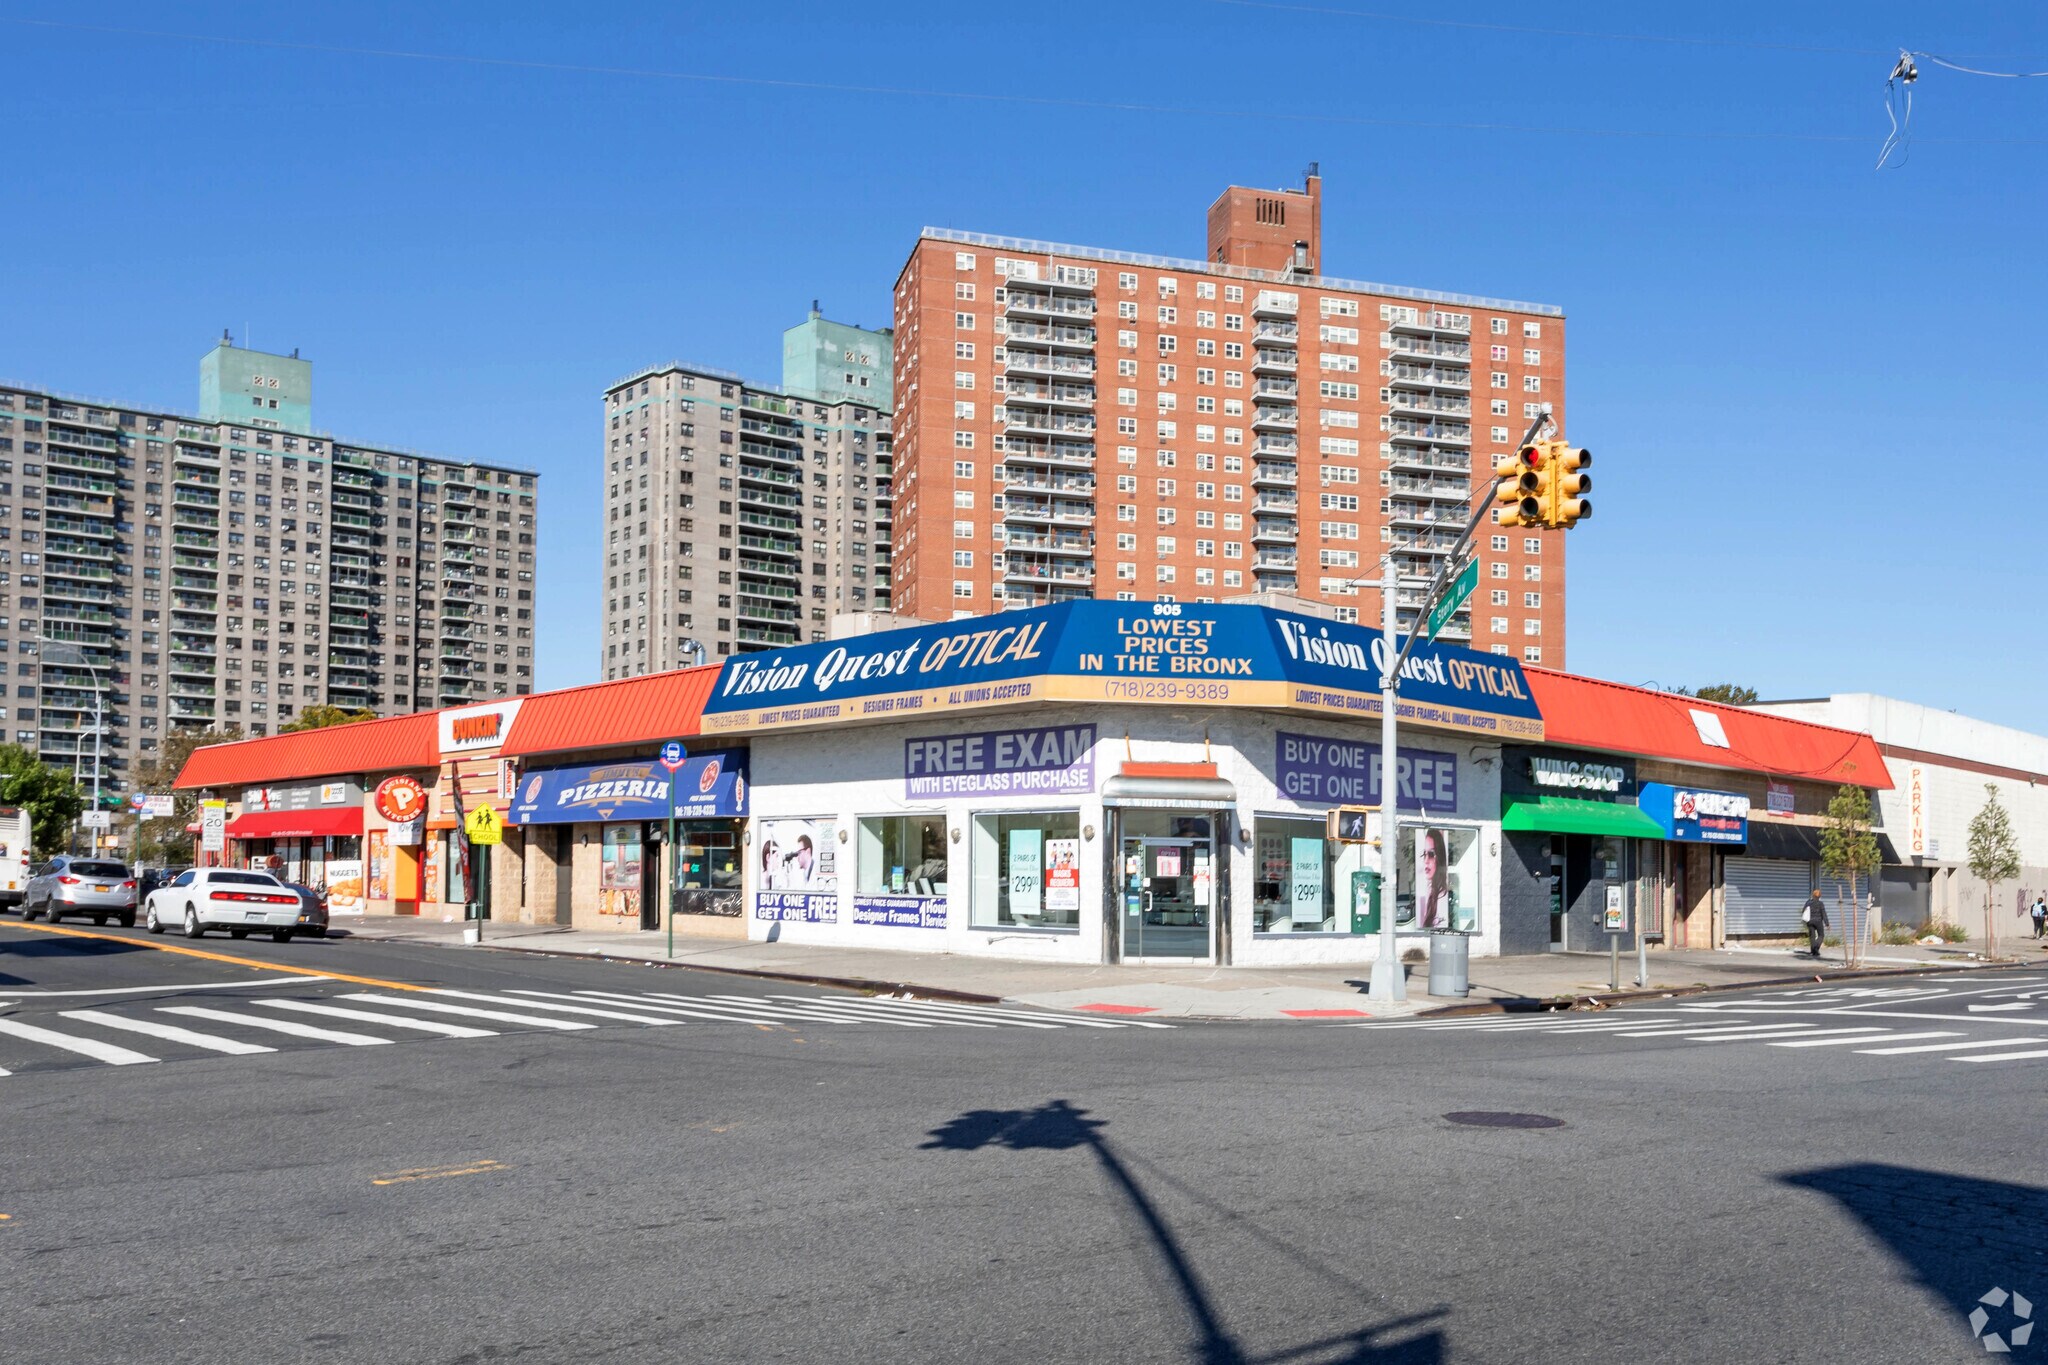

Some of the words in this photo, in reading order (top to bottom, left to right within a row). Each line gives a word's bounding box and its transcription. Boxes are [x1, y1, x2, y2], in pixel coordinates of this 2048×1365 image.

[1153, 604, 1181, 616] 905
[1437, 596, 1454, 625] Story
[1118, 618, 1216, 637] LOWEST
[1125, 637, 1208, 655] PRICES
[722, 657, 809, 698] Vision
[814, 638, 921, 692] Quest
[919, 621, 1048, 673] OPTICAL
[1080, 654, 1103, 671] IN
[1114, 655, 1160, 672] THE
[1171, 657, 1253, 675] BRONX
[1275, 618, 1369, 671] Vision
[1448, 658, 1528, 700] OPTICAL
[1105, 680, 1229, 699] (718)239-9389
[759, 712, 780, 725] LOWEST
[781, 709, 801, 721] PRICES
[802, 704, 840, 719] GUARANTEED
[863, 700, 894, 714] DESIGNER
[896, 695, 923, 709] FRAMES
[948, 692, 963, 705] ALL
[964, 687, 991, 702] UNIONS
[993, 683, 1032, 698] ACCEPTED
[1296, 689, 1322, 705] LOWEST
[1322, 692, 1347, 708] PRICES
[1394, 702, 1415, 718] SIGNER
[1417, 706, 1439, 722] FRAMES
[1441, 710, 1451, 723] ALL
[1452, 712, 1471, 726] UNIONS
[1472, 715, 1497, 730] ACCEPTED
[453, 713, 500, 741] DUNKIN'
[908, 736, 984, 774] FREE
[995, 729, 1092, 769] EXAM
[1284, 739, 1324, 764] BUY
[1327, 745, 1365, 770] ONE
[382, 779, 424, 797] LOUISIANA
[910, 776, 941, 794] WITH
[943, 772, 1010, 793] EYEGLASS
[1013, 768, 1089, 789] PURCHASE
[1284, 771, 1322, 796] GET
[1327, 775, 1364, 799] ONE
[1370, 753, 1454, 801] FREE
[391, 787, 415, 811] P
[557, 780, 670, 806] PIZZERIA
[1133, 798, 1166, 807] WHITE
[1167, 799, 1200, 808] PLAINS
[1200, 799, 1226, 809] ROAD
[382, 805, 421, 821] KITCHEN
[1912, 769, 1923, 851] PARKING
[206, 818, 222, 828] 20
[470, 833, 498, 841] SCHOOL
[330, 869, 358, 877] NUGGETS
[760, 894, 781, 906] BUY
[783, 894, 805, 907] ONE
[808, 896, 836, 920] FREE
[872, 899, 887, 907] PRICE
[887, 899, 919, 908] GUARANTEED
[919, 901, 926, 926] 1
[926, 898, 947, 914] Hour
[758, 907, 781, 920] GET
[783, 908, 807, 920] ONE
[854, 907, 888, 925] Designer
[889, 909, 919, 924] Frames
